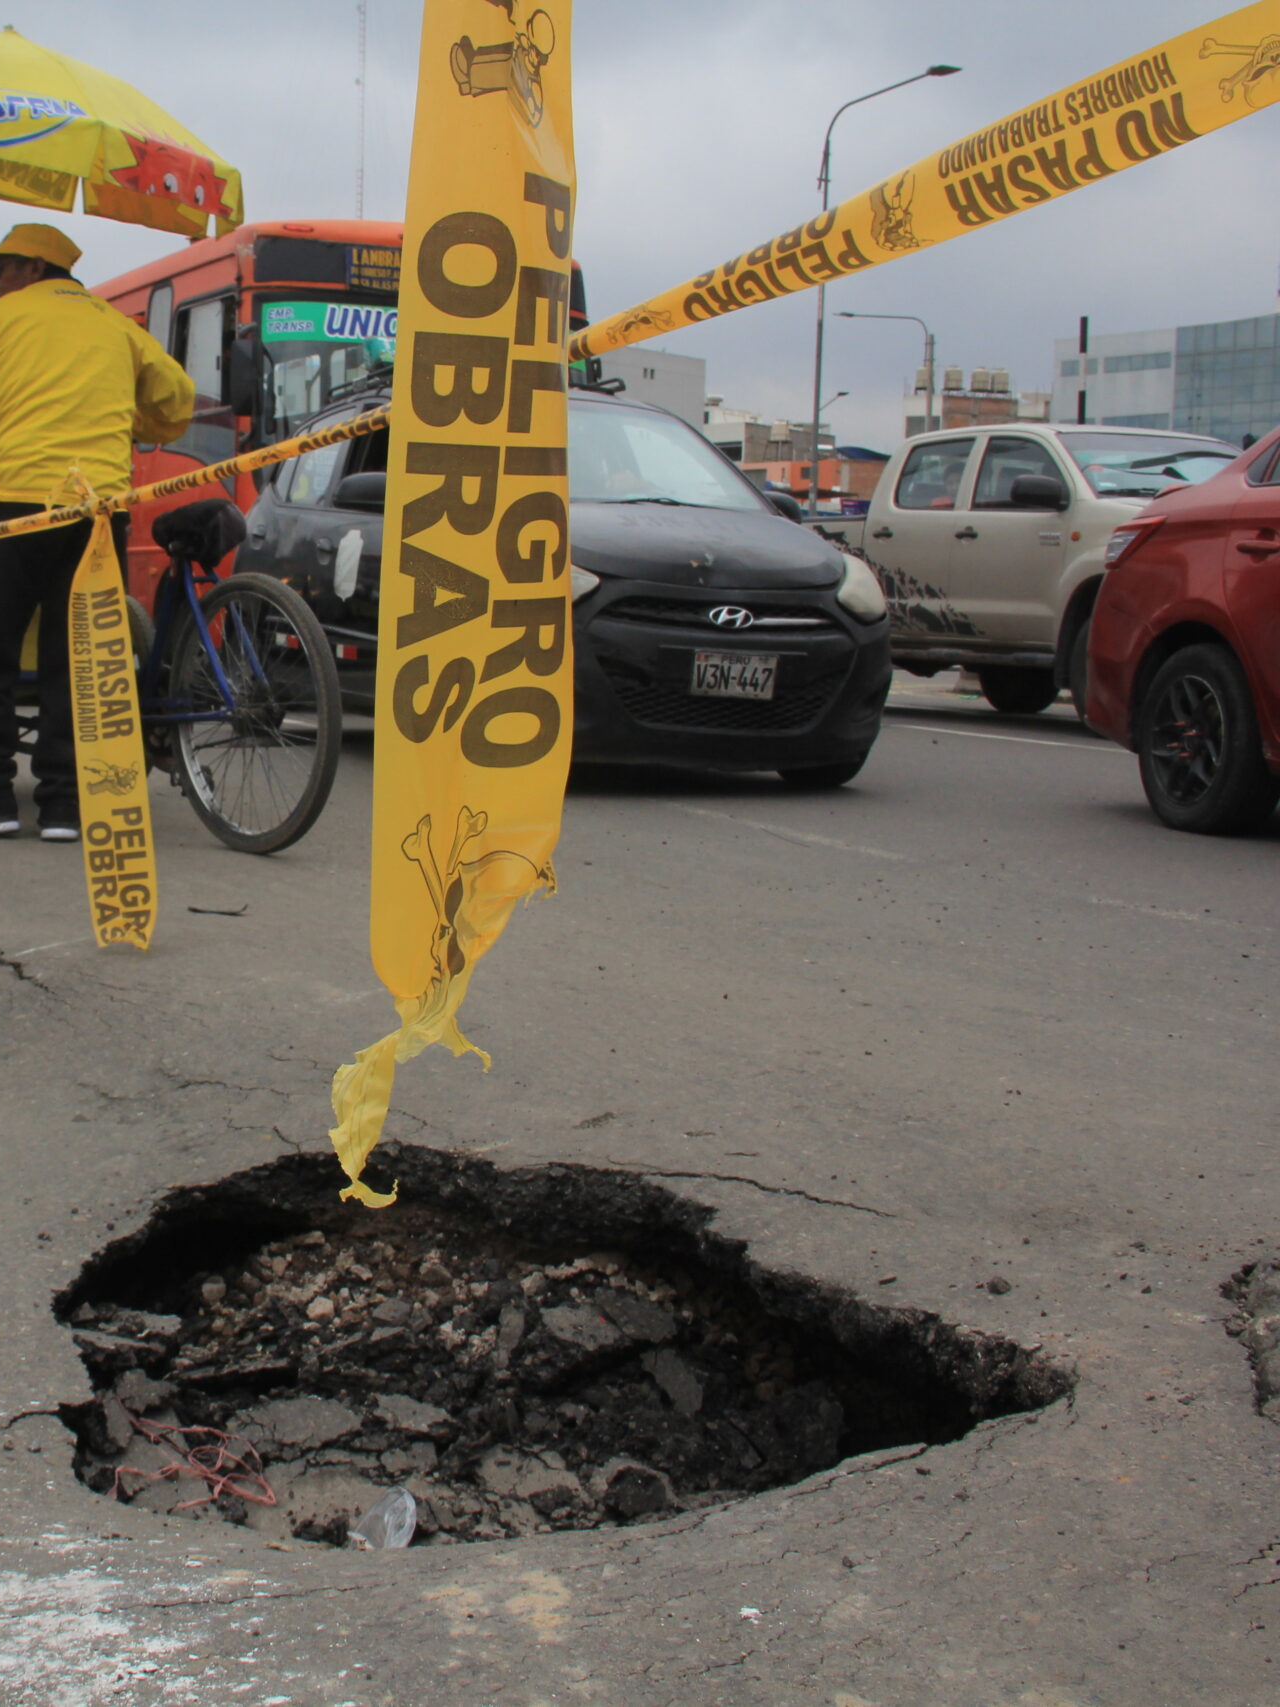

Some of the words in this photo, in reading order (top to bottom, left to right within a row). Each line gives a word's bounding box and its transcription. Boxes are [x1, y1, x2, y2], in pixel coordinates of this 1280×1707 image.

[1067, 51, 1177, 126] HOMBRES
[1116, 91, 1203, 162] NO
[937, 98, 1066, 179] TRABAJANDO
[944, 127, 1120, 227] PASAR
[267, 307, 295, 321] EMP.
[682, 229, 874, 322] PELIGRO
[393, 212, 517, 743] OBRAS
[460, 171, 570, 769] PELIGRO
[71, 592, 92, 656] HOMBRES
[91, 585, 123, 630] NO
[74, 659, 98, 743] TRABAJANDO
[95, 637, 134, 740] PASAR
[696, 663, 773, 693] V3N-447
